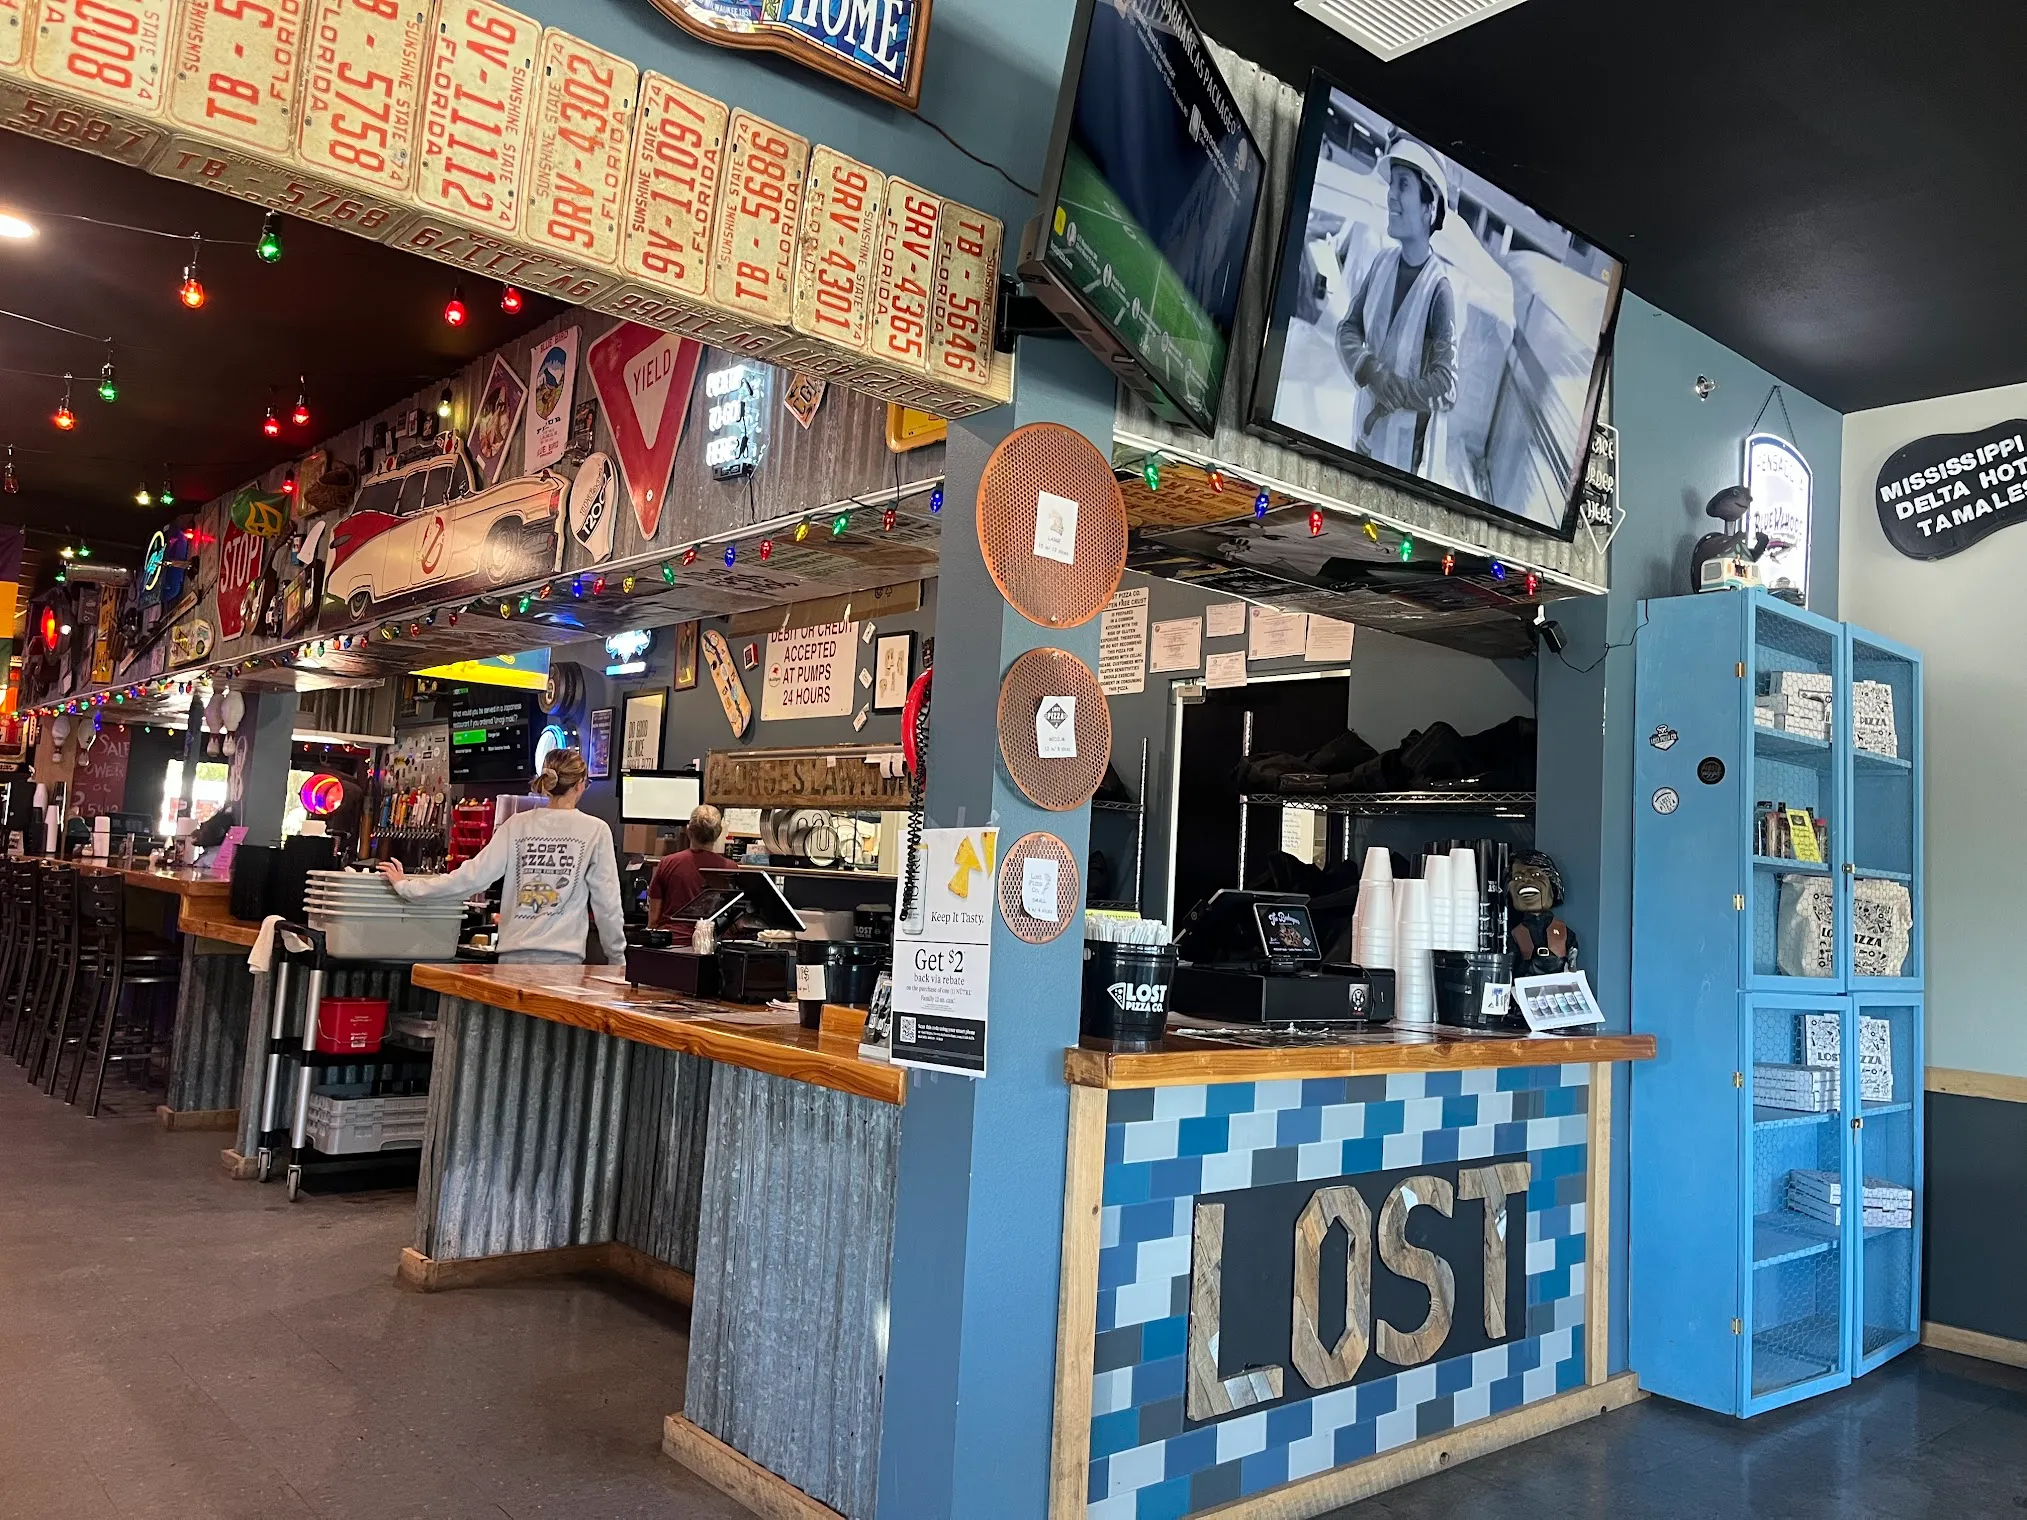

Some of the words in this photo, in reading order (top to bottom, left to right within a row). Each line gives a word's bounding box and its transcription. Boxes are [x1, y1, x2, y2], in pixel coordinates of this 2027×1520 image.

[66, 0, 140, 88] 008
[139, 10, 160, 56] STATE
[398, 20, 419, 91] SUNSHINE
[137, 75, 155, 100] 74
[426, 36, 457, 157] FLORIDA
[504, 66, 526, 136] SUNSHINE
[545, 82, 562, 125] STATE
[391, 98, 411, 144] STATE
[500, 143, 516, 185] STATE
[536, 129, 558, 198] SUNSHINE
[546, 54, 615, 249] 9RV-4302
[601, 110, 625, 221] FLORIDA
[632, 169, 651, 233] SUNSHINE
[642, 124, 658, 163] STATE
[650, 85, 661, 107] 74
[641, 94, 707, 280] 9V-1097
[692, 149, 717, 253] FLORIDA
[498, 200, 513, 223] 74
[720, 204, 737, 264] SUNSHINE
[729, 158, 744, 196] STATE
[775, 183, 800, 282] FLORIDA
[814, 165, 868, 331] 9RV-4301
[857, 210, 874, 269] SUNSHINE
[876, 219, 898, 315] FLORIDA
[888, 195, 938, 360] 9RV-4365
[933, 241, 952, 334] FLORIDA
[983, 256, 996, 316] SUNSHINE
[853, 272, 866, 309] STATE
[979, 316, 991, 350] STATE
[632, 349, 671, 396] YIELD
[1880, 435, 2025, 502] MISSISSIPPI
[1895, 480, 1971, 520] DELTA
[1979, 456, 2027, 489] HOT
[1586, 499, 1613, 525] HERE
[221, 532, 260, 593] STOP
[1119, 590, 1132, 599] PIZZA
[784, 641, 837, 663] ACCEPTED
[817, 622, 852, 637] CREDIT
[783, 667, 795, 684] AT
[797, 663, 831, 683] PUMPS
[783, 689, 793, 706] 24
[796, 686, 830, 705] HOURS
[628, 721, 636, 738] DO
[636, 720, 648, 738] GOOD
[1047, 712, 1064, 720] PIZZA
[1860, 718, 1887, 726] PIZZA
[627, 740, 634, 758] BE
[526, 843, 568, 854] LOST
[931, 911, 951, 924] Keep
[952, 912, 960, 924] It
[960, 912, 985, 926] Tasty.
[1854, 934, 1882, 948] IZZA
[914, 973, 930, 983] back
[930, 974, 942, 984] via
[942, 975, 965, 986] rebate
[915, 948, 944, 972] Get
[1126, 982, 1168, 1003] LOST
[1126, 1002, 1151, 1012] PIZZA
[1152, 1002, 1164, 1013] CO.
[1187, 1162, 1532, 1422] LOST
